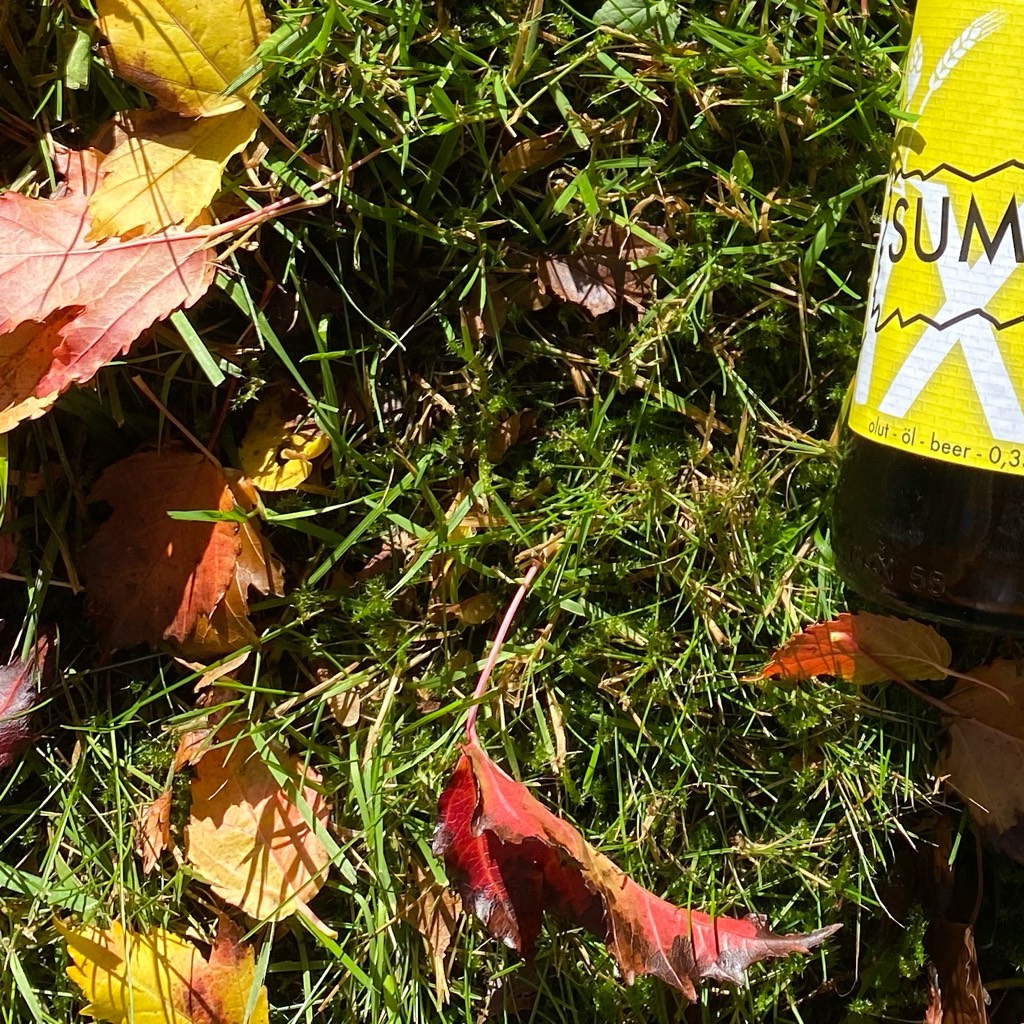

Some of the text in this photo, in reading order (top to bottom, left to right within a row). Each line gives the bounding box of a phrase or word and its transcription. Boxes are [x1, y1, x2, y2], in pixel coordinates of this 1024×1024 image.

[868, 416, 889, 438] olut
[901, 427, 916, 446] öl
[930, 432, 971, 458] beer
